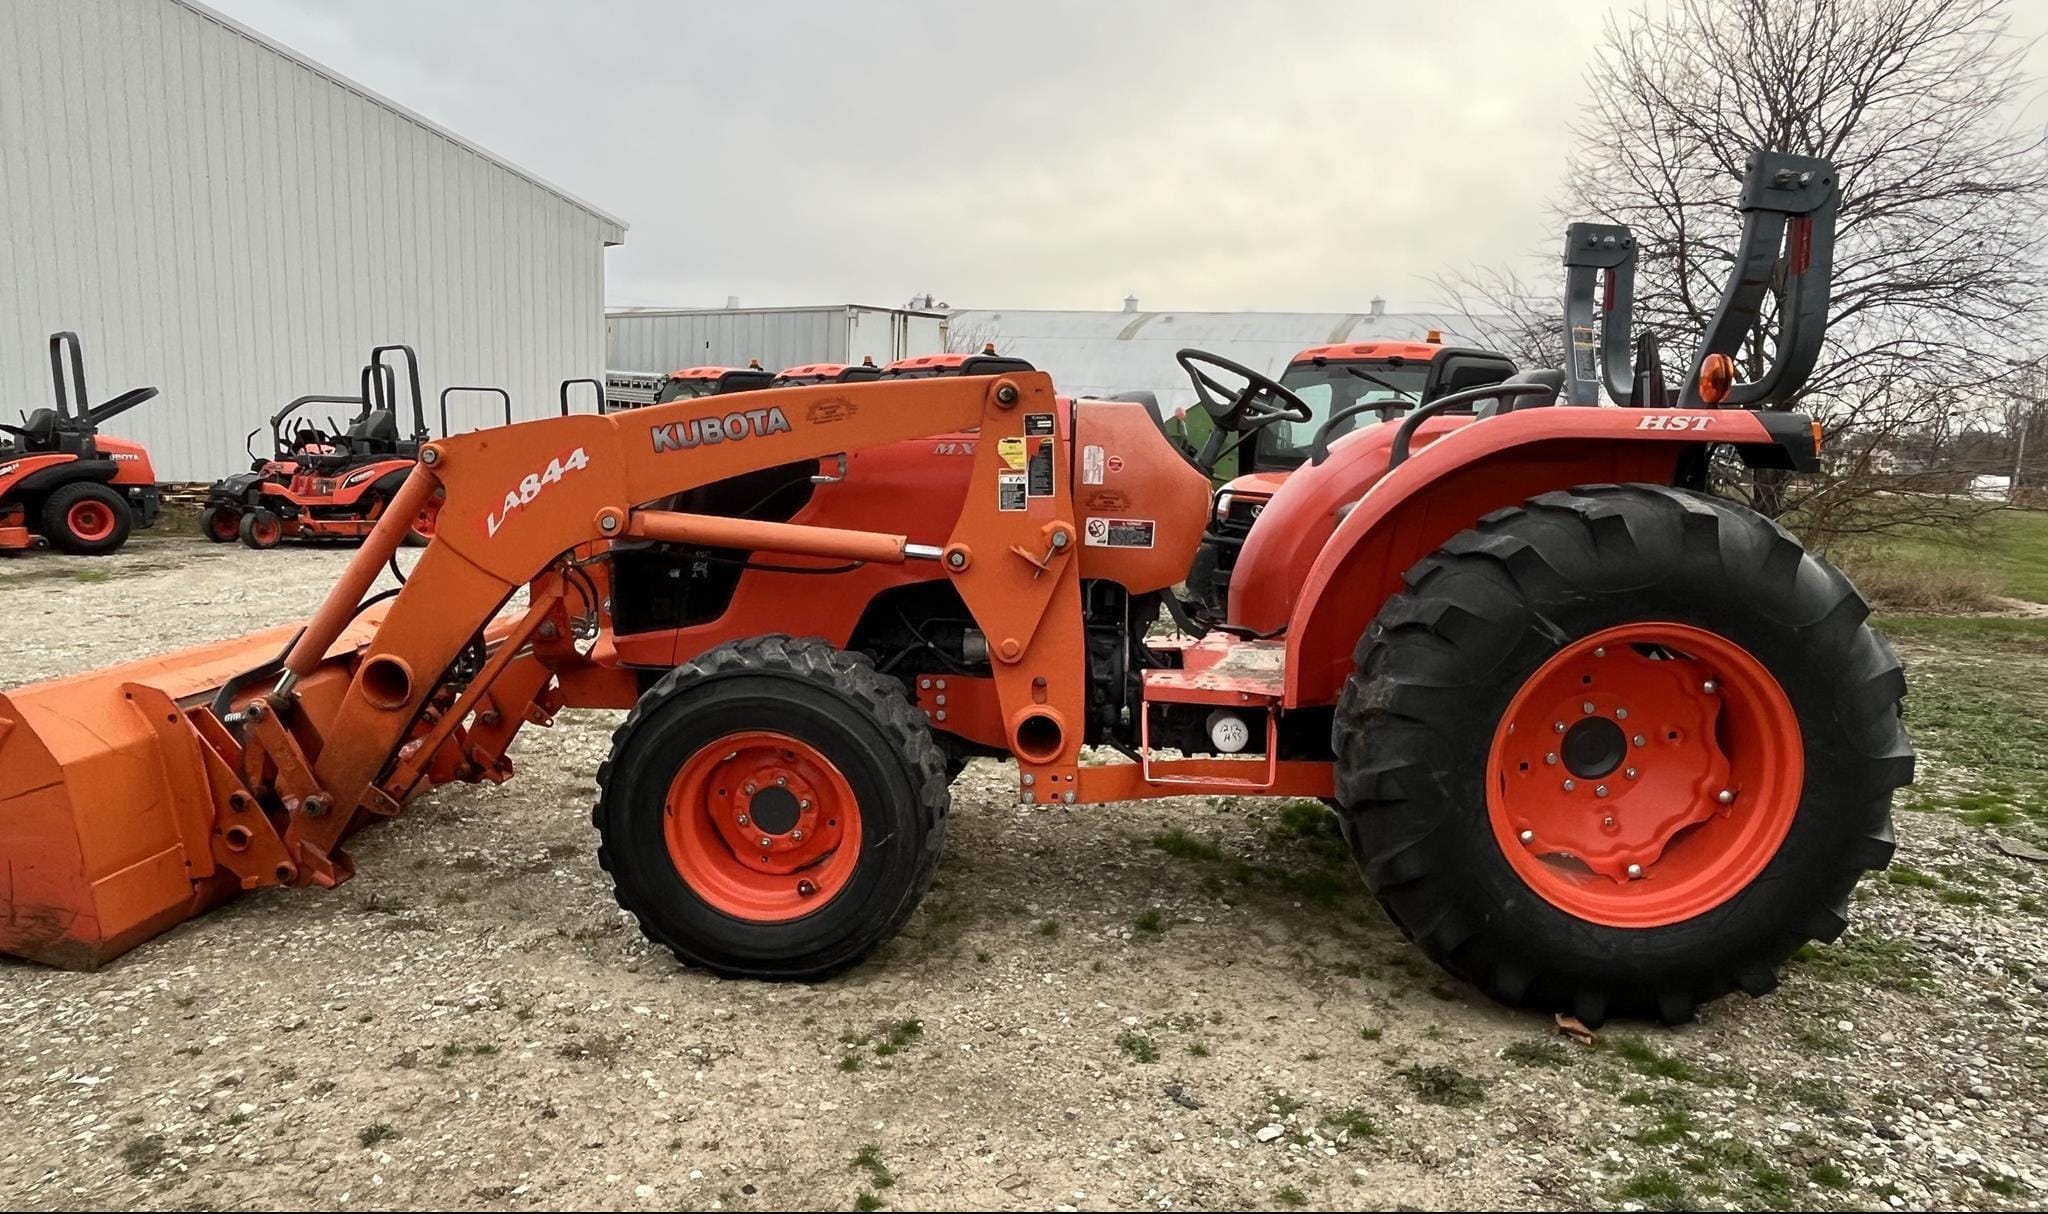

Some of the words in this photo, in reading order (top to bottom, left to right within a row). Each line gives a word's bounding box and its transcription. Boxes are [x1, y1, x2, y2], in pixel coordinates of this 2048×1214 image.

[651, 406, 792, 453] KUBOTA
[1635, 415, 1717, 431] HST
[108, 453, 140, 461] UBOTA
[487, 447, 590, 538] LA844
